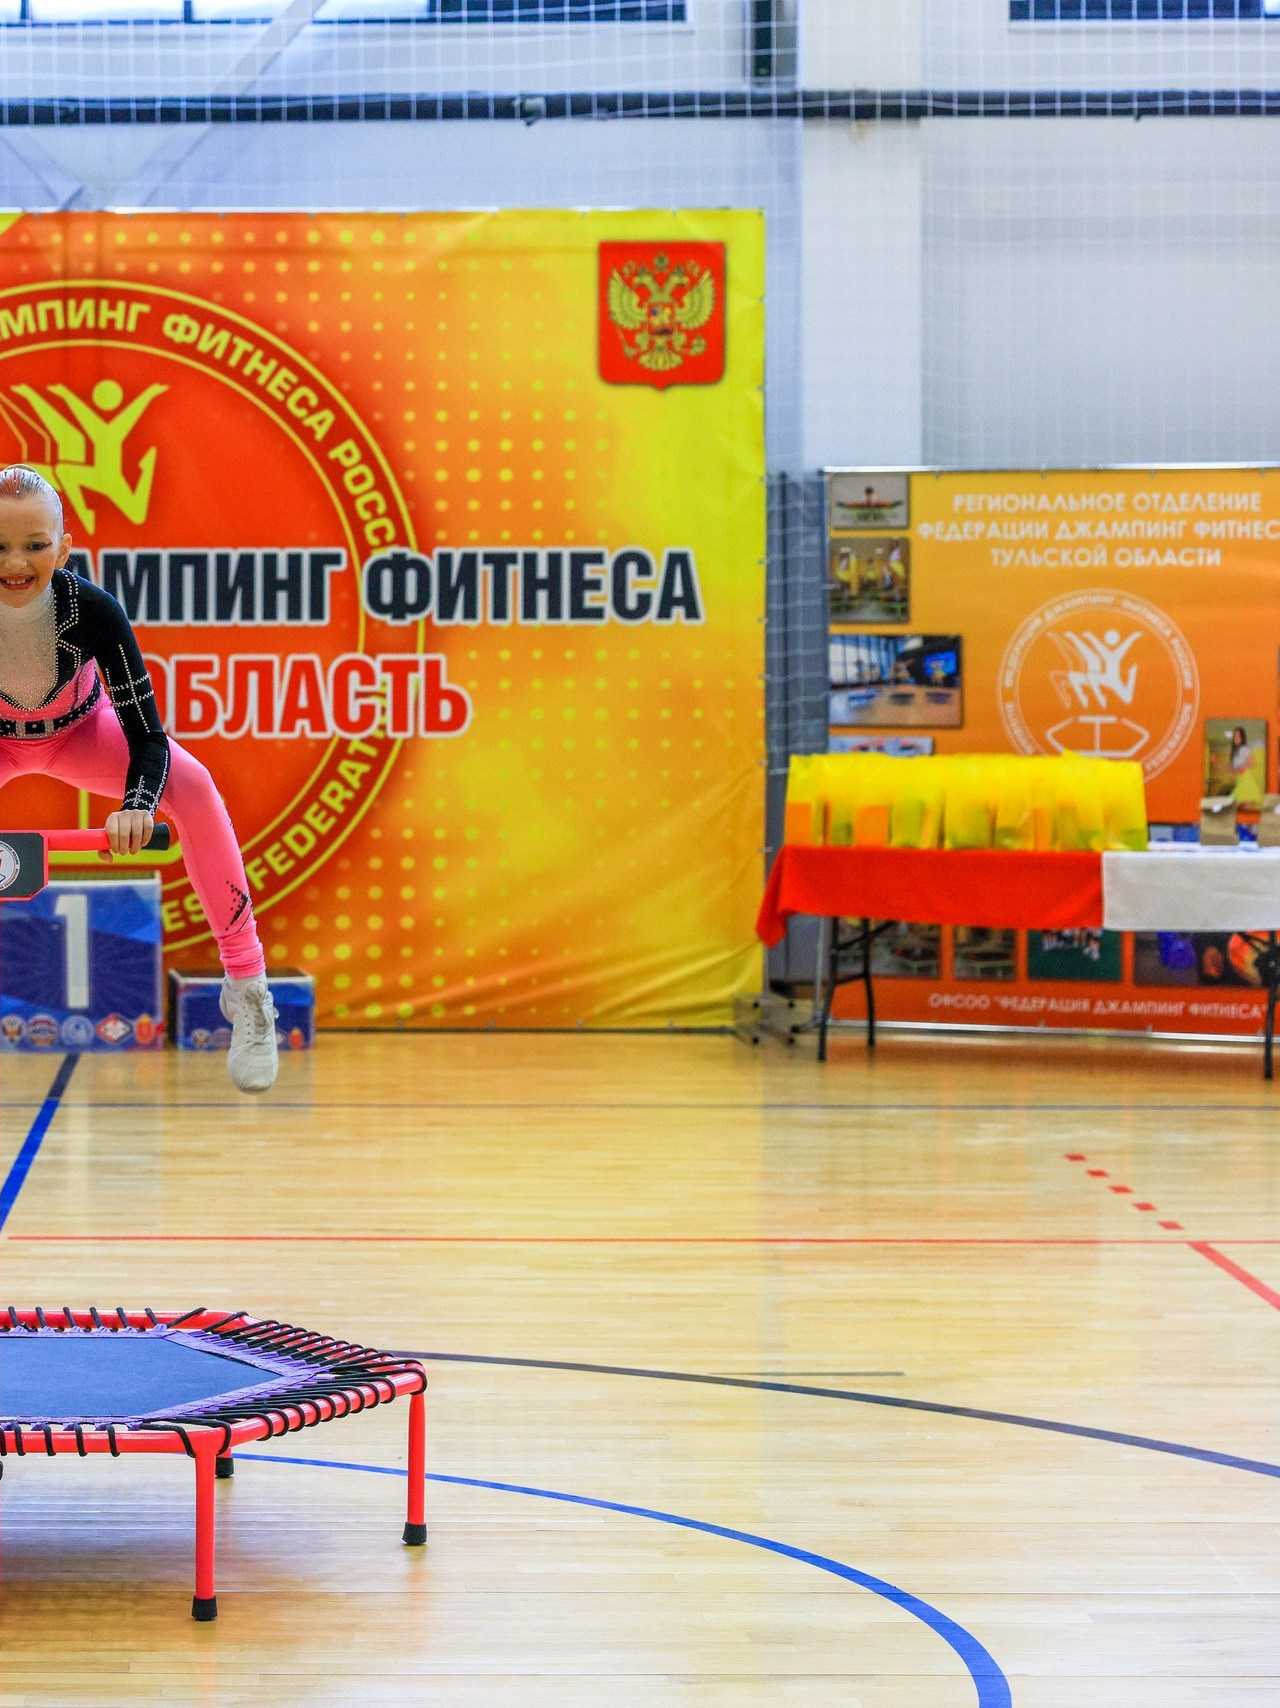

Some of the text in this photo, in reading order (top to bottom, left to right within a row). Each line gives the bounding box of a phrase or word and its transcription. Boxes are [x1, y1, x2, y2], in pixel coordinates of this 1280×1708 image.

[163, 314, 336, 440] ФИТНЕСА
[327, 438, 399, 556] РОСС
[952, 493, 1262, 514] РЕГИОНАЛЬНОЕ ОТДЕЛЕНИЕ
[917, 520, 1049, 542] ФЕДЕРАЦИИ
[1055, 520, 1186, 542] ДЖАМПИНГ
[991, 544, 1222, 568] ТУЛЬСКОЙ ОБЛАСТИ
[364, 547, 706, 627] ФИТНЕСА
[53, 893, 89, 1010] 1
